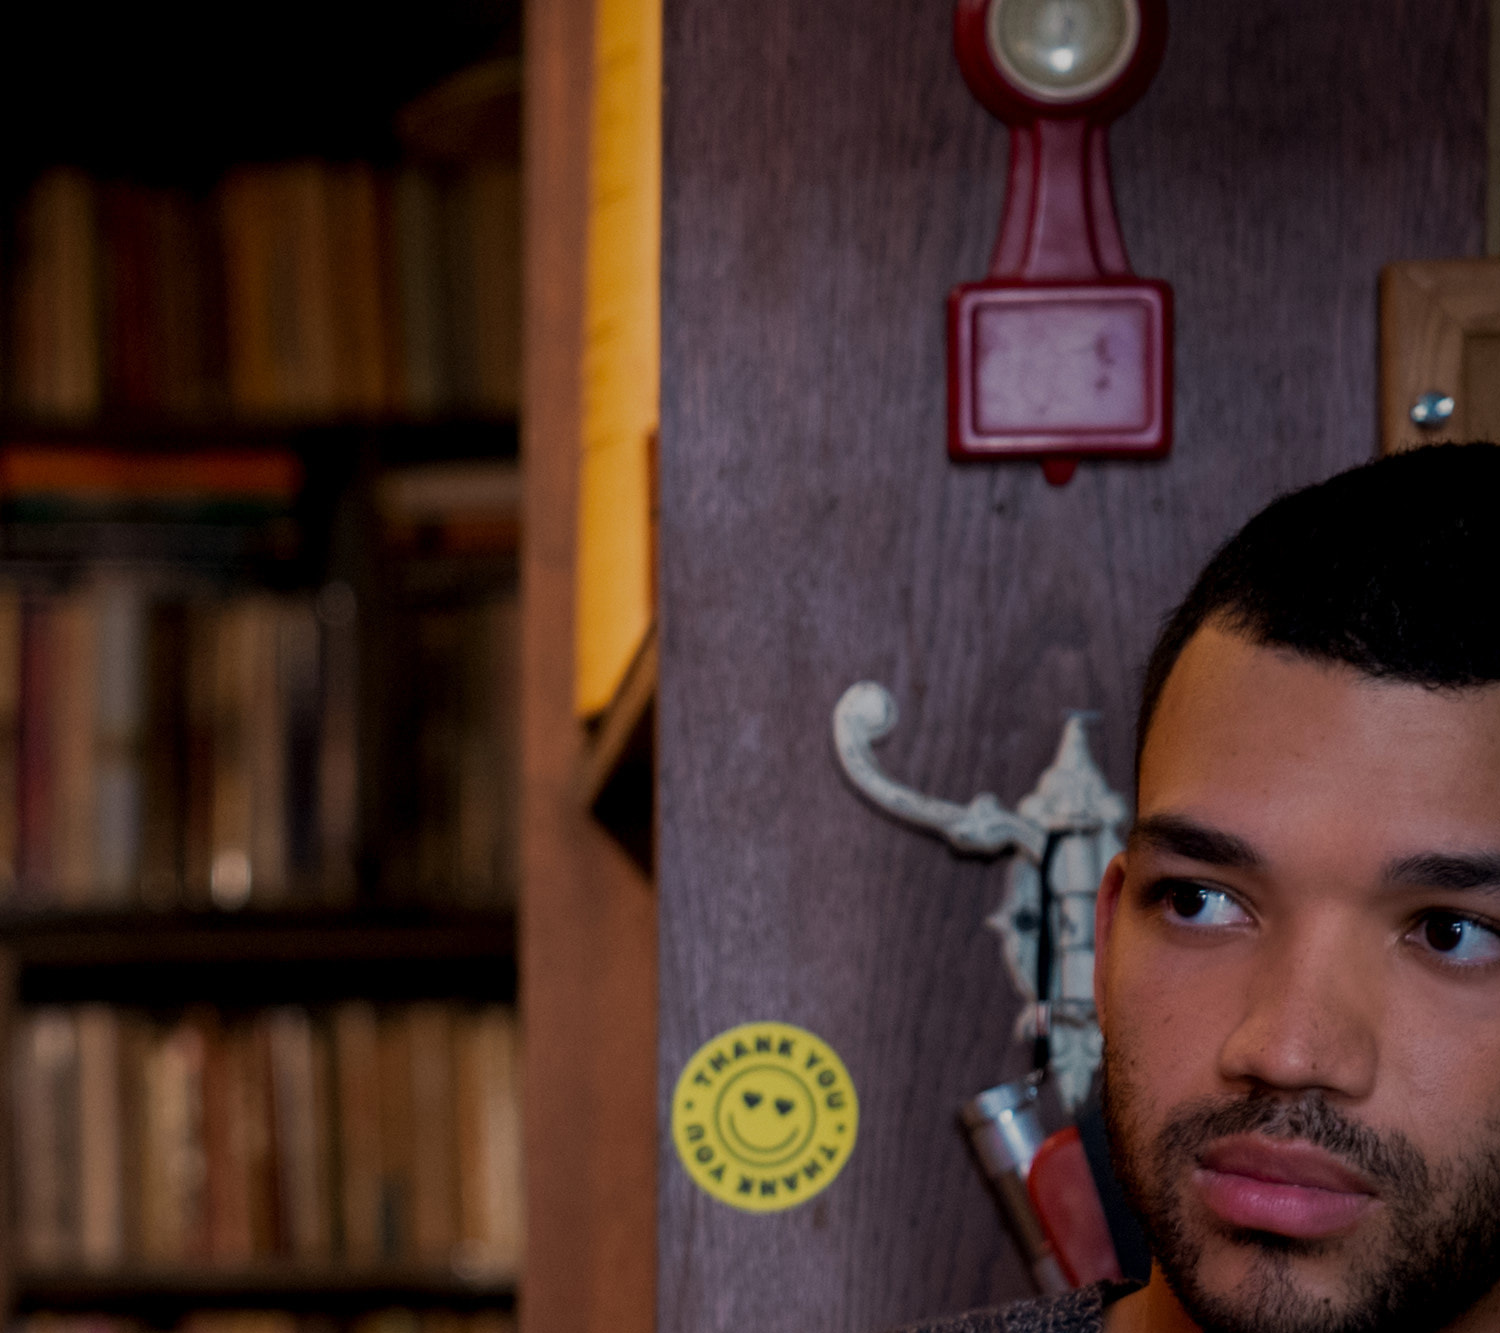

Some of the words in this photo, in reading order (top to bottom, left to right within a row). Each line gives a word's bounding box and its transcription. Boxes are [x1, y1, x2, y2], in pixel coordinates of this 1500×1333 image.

[693, 1035, 796, 1086] THANK
[806, 1050, 844, 1111] YOU
[686, 1125, 727, 1183] YOU
[737, 1144, 838, 1196] THANK
